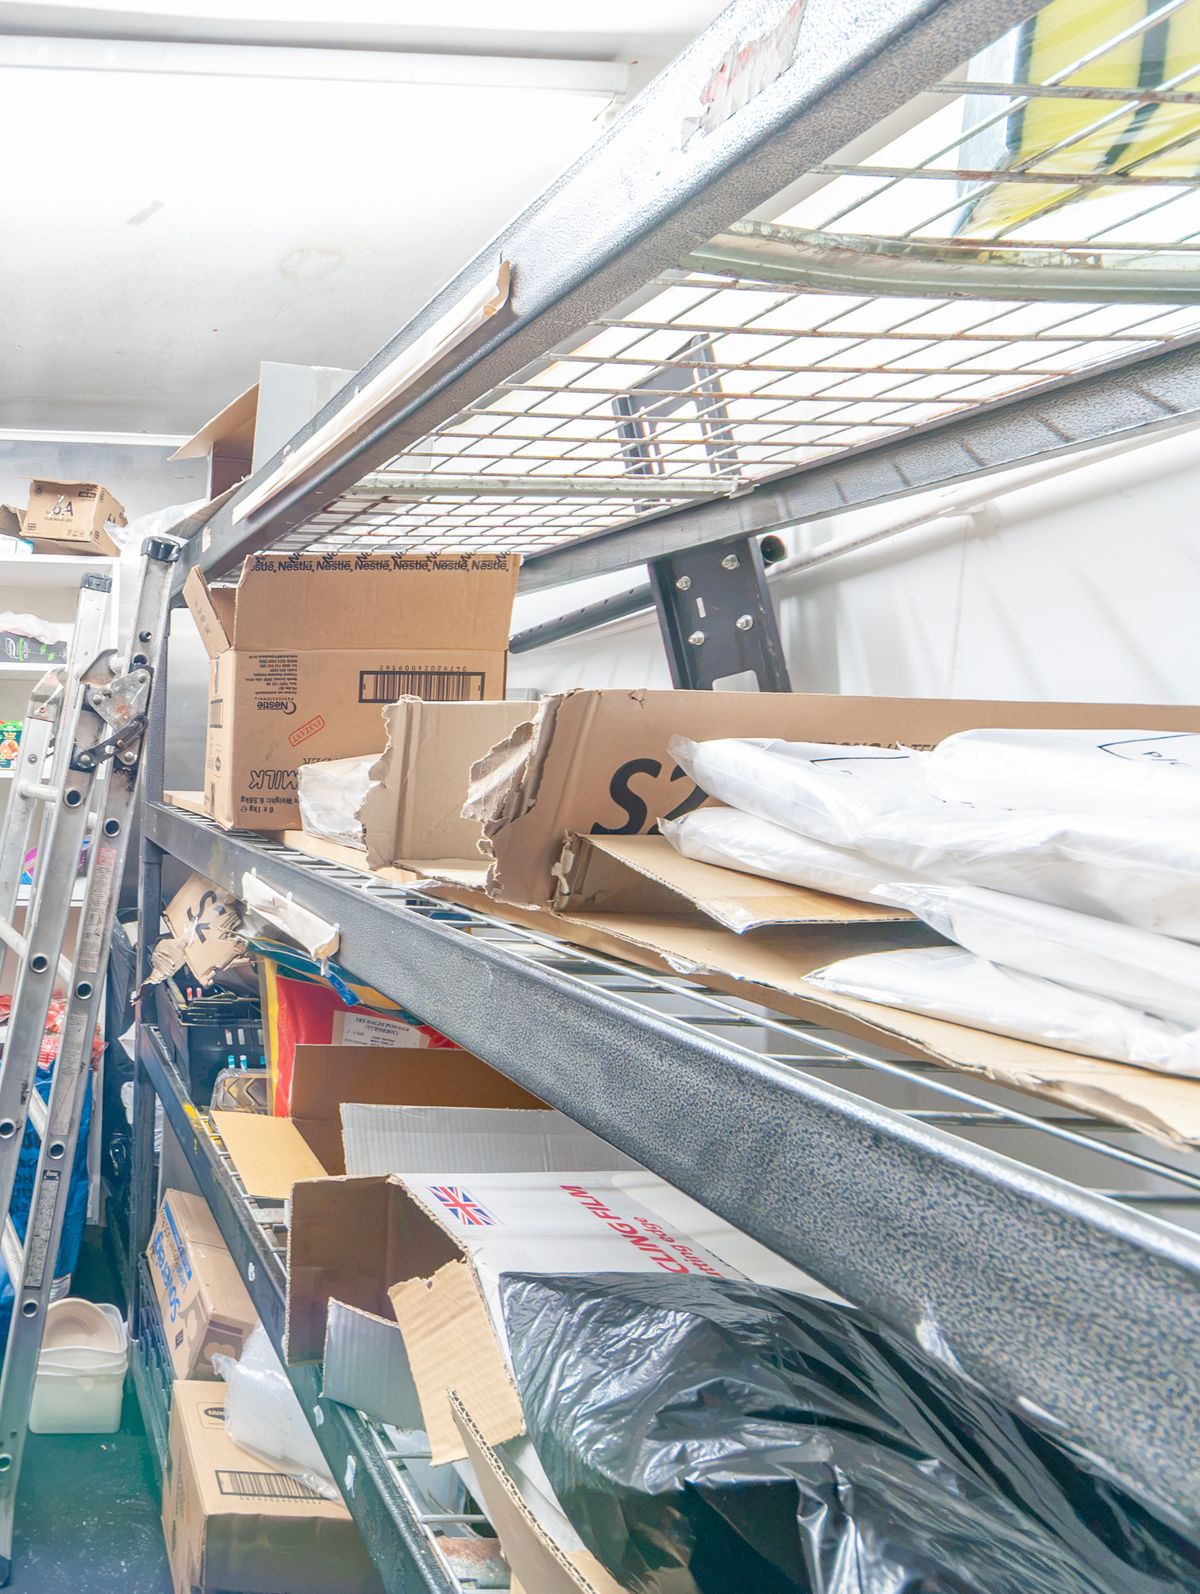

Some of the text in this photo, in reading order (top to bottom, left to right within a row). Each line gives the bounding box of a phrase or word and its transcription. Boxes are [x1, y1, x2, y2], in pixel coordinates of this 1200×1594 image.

[248, 769, 298, 790] MILK
[559, 1184, 690, 1275] CLING FILM
[633, 1216, 675, 1245] edge
